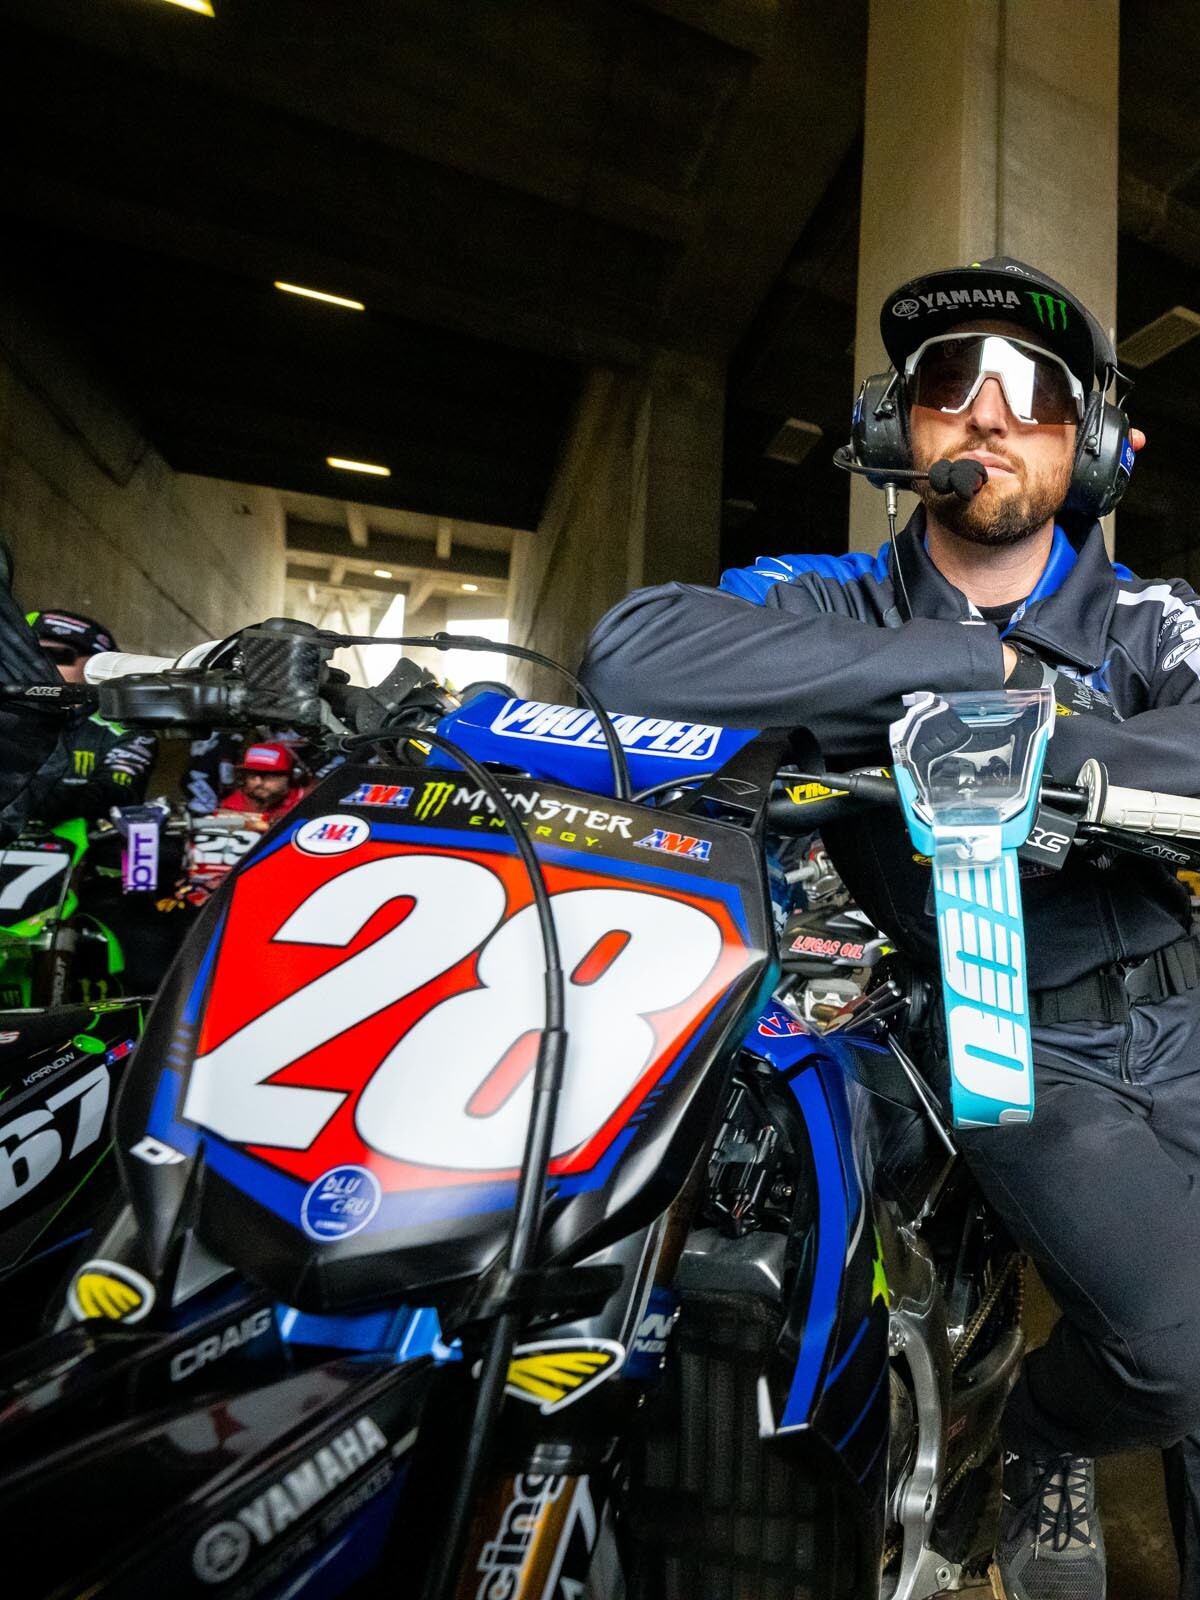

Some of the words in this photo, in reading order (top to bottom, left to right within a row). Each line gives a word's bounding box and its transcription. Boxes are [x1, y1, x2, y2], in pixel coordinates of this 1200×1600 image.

[920, 289, 1021, 308] YAMAHA
[907, 302, 1016, 320] RACING
[25, 686, 62, 697] ARC
[339, 783, 415, 807] AMA
[308, 823, 359, 843] AMA
[468, 815, 600, 847] ENRGY
[632, 828, 713, 862] AMA
[1143, 846, 1192, 865] ARC
[791, 935, 840, 956] LUCAS
[839, 940, 866, 959] OIL
[183, 853, 724, 1176] 28
[0, 1063, 111, 1212] 67
[170, 1307, 272, 1382] CRAIG
[238, 1416, 388, 1545] YAMAHA
